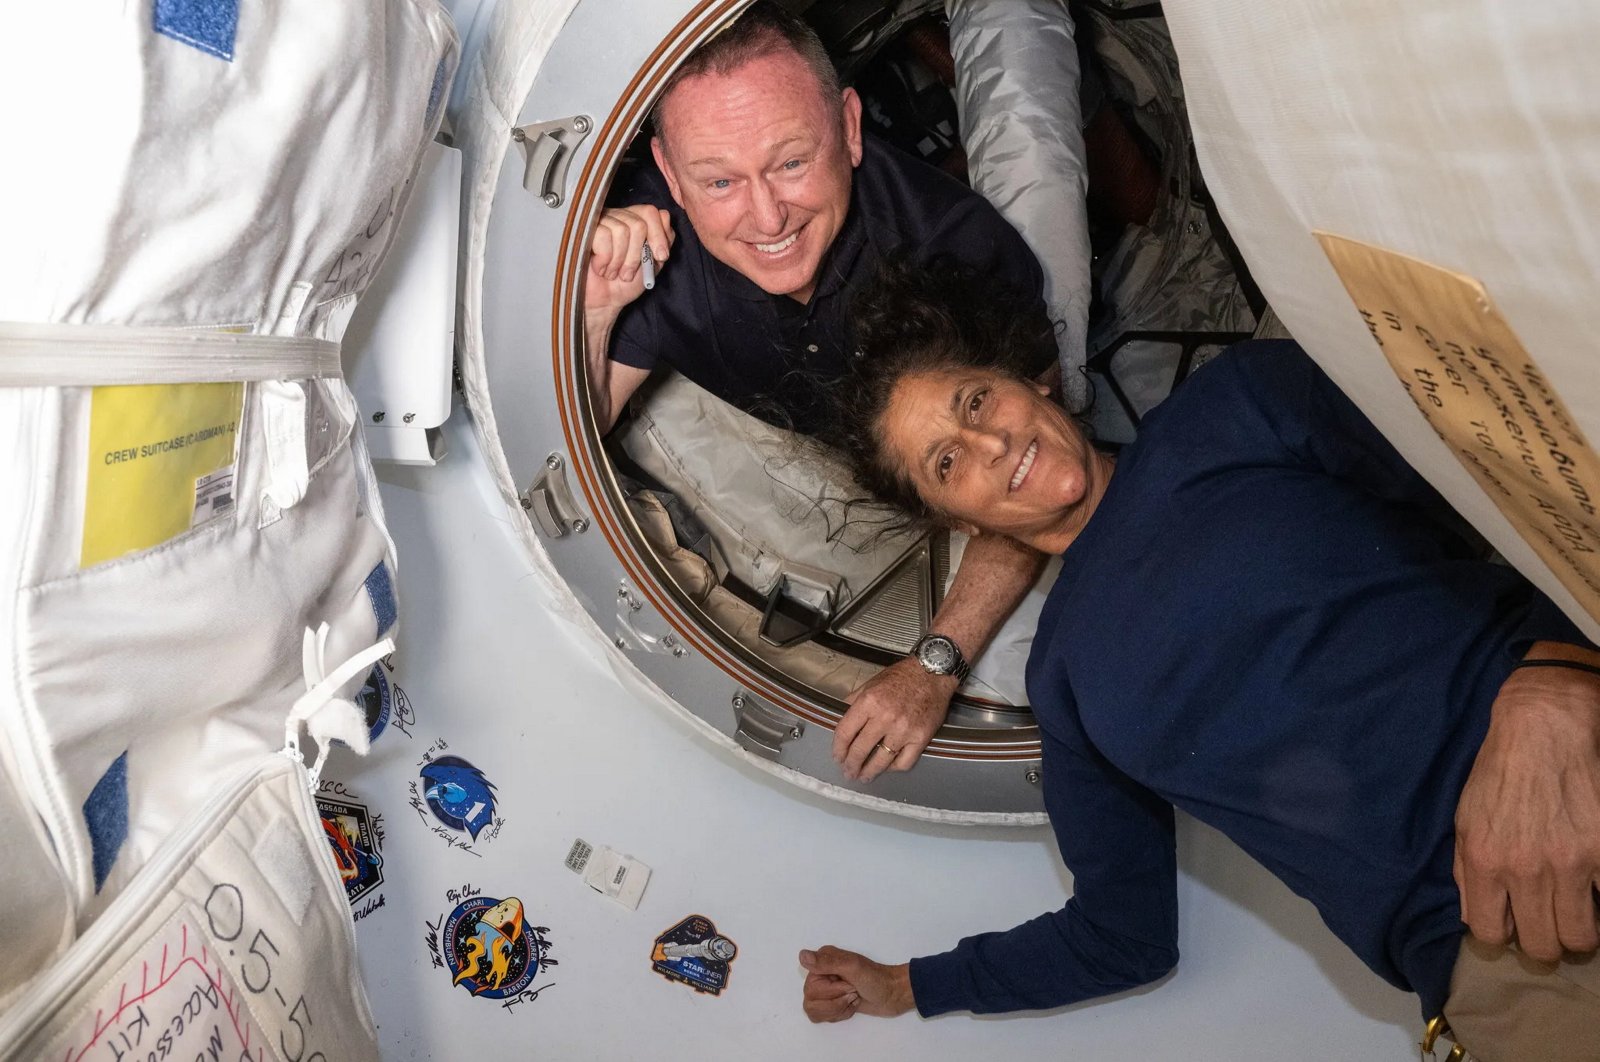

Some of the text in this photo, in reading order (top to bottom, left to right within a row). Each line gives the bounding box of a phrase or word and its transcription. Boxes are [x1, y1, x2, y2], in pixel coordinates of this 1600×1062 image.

[1381, 310, 1402, 331] in
[1414, 368, 1443, 407] the
[1415, 325, 1470, 395] cover
[104, 447, 139, 465] CREW
[141, 436, 185, 458] SUITCASE
[315, 801, 348, 814] ASSADA
[463, 899, 485, 911] CHARI
[444, 916, 457, 966] MARSHBURN
[526, 930, 537, 962] MAURER
[204, 883, 328, 1062] 0.5-5
[503, 973, 532, 996] BARRON
[682, 960, 722, 980] STARLINER
[107, 1005, 150, 1062] KIT
